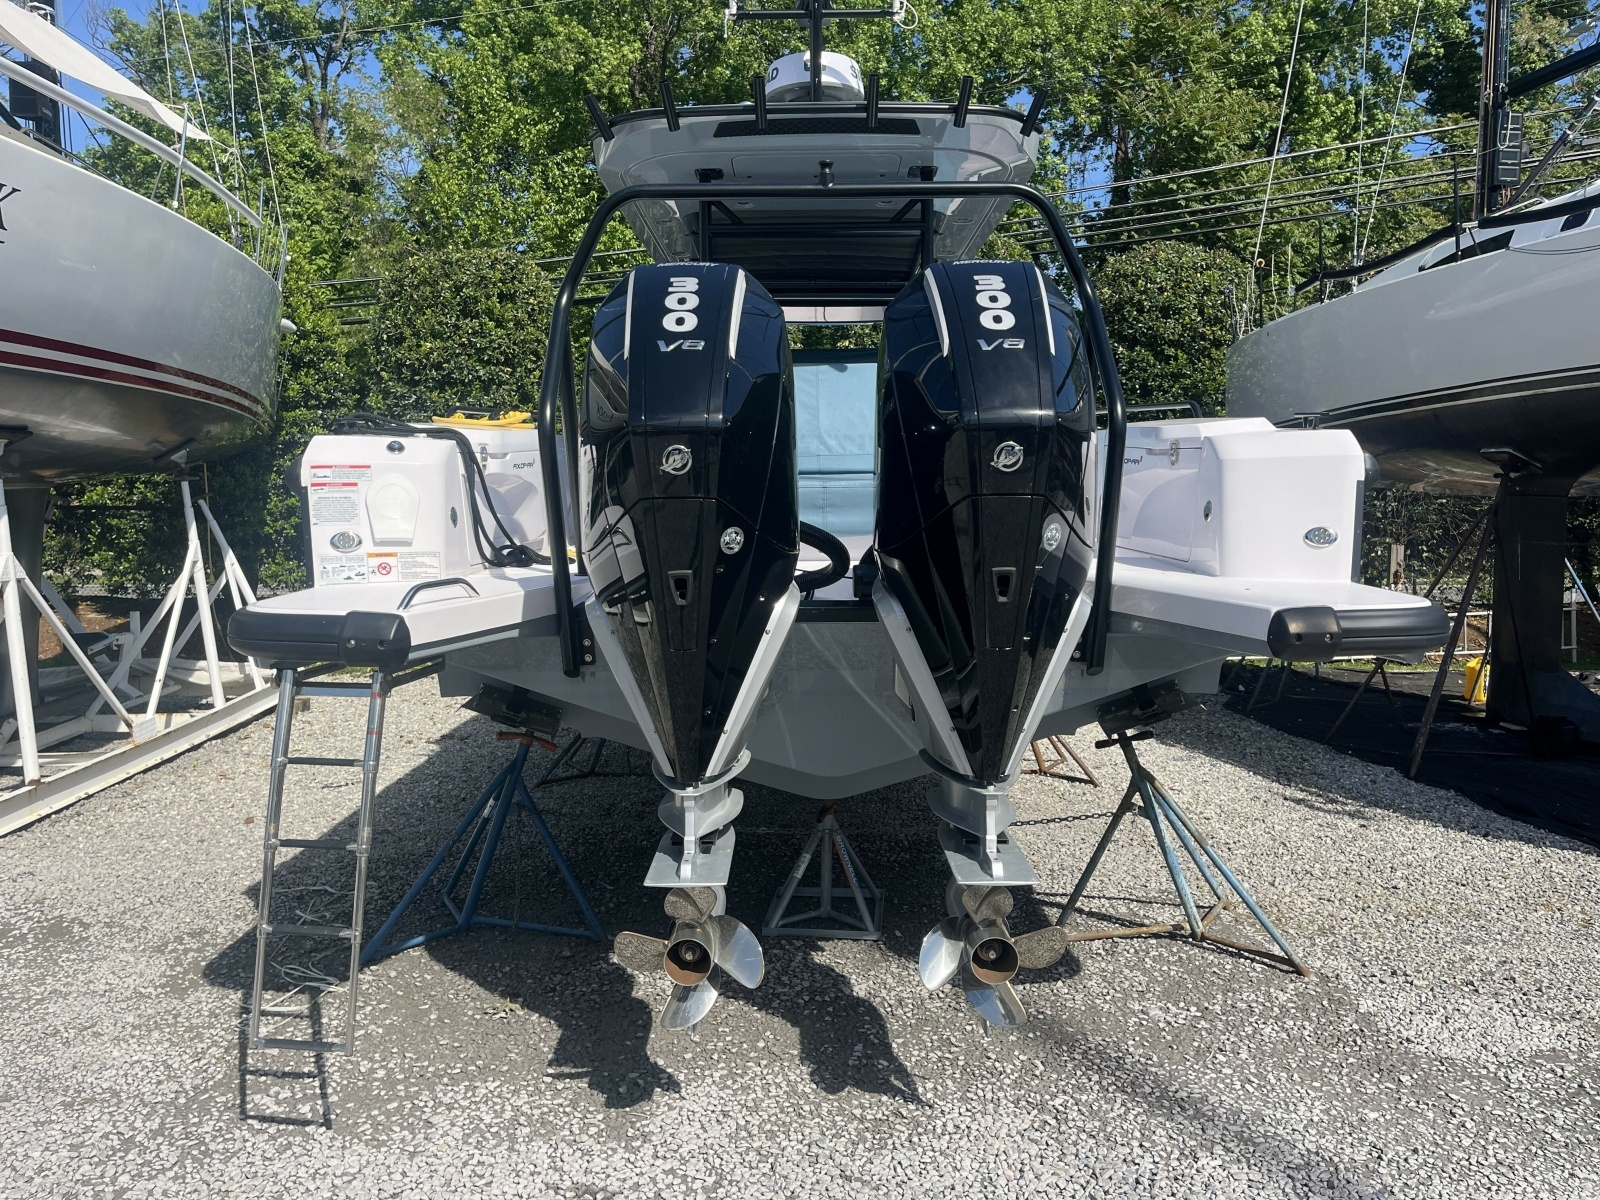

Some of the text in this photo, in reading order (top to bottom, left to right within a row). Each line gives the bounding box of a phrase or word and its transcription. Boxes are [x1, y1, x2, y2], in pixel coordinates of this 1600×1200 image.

[662, 276, 700, 333] 300
[973, 274, 1016, 331] 300
[656, 339, 706, 352] V8
[976, 338, 1026, 351] V8
